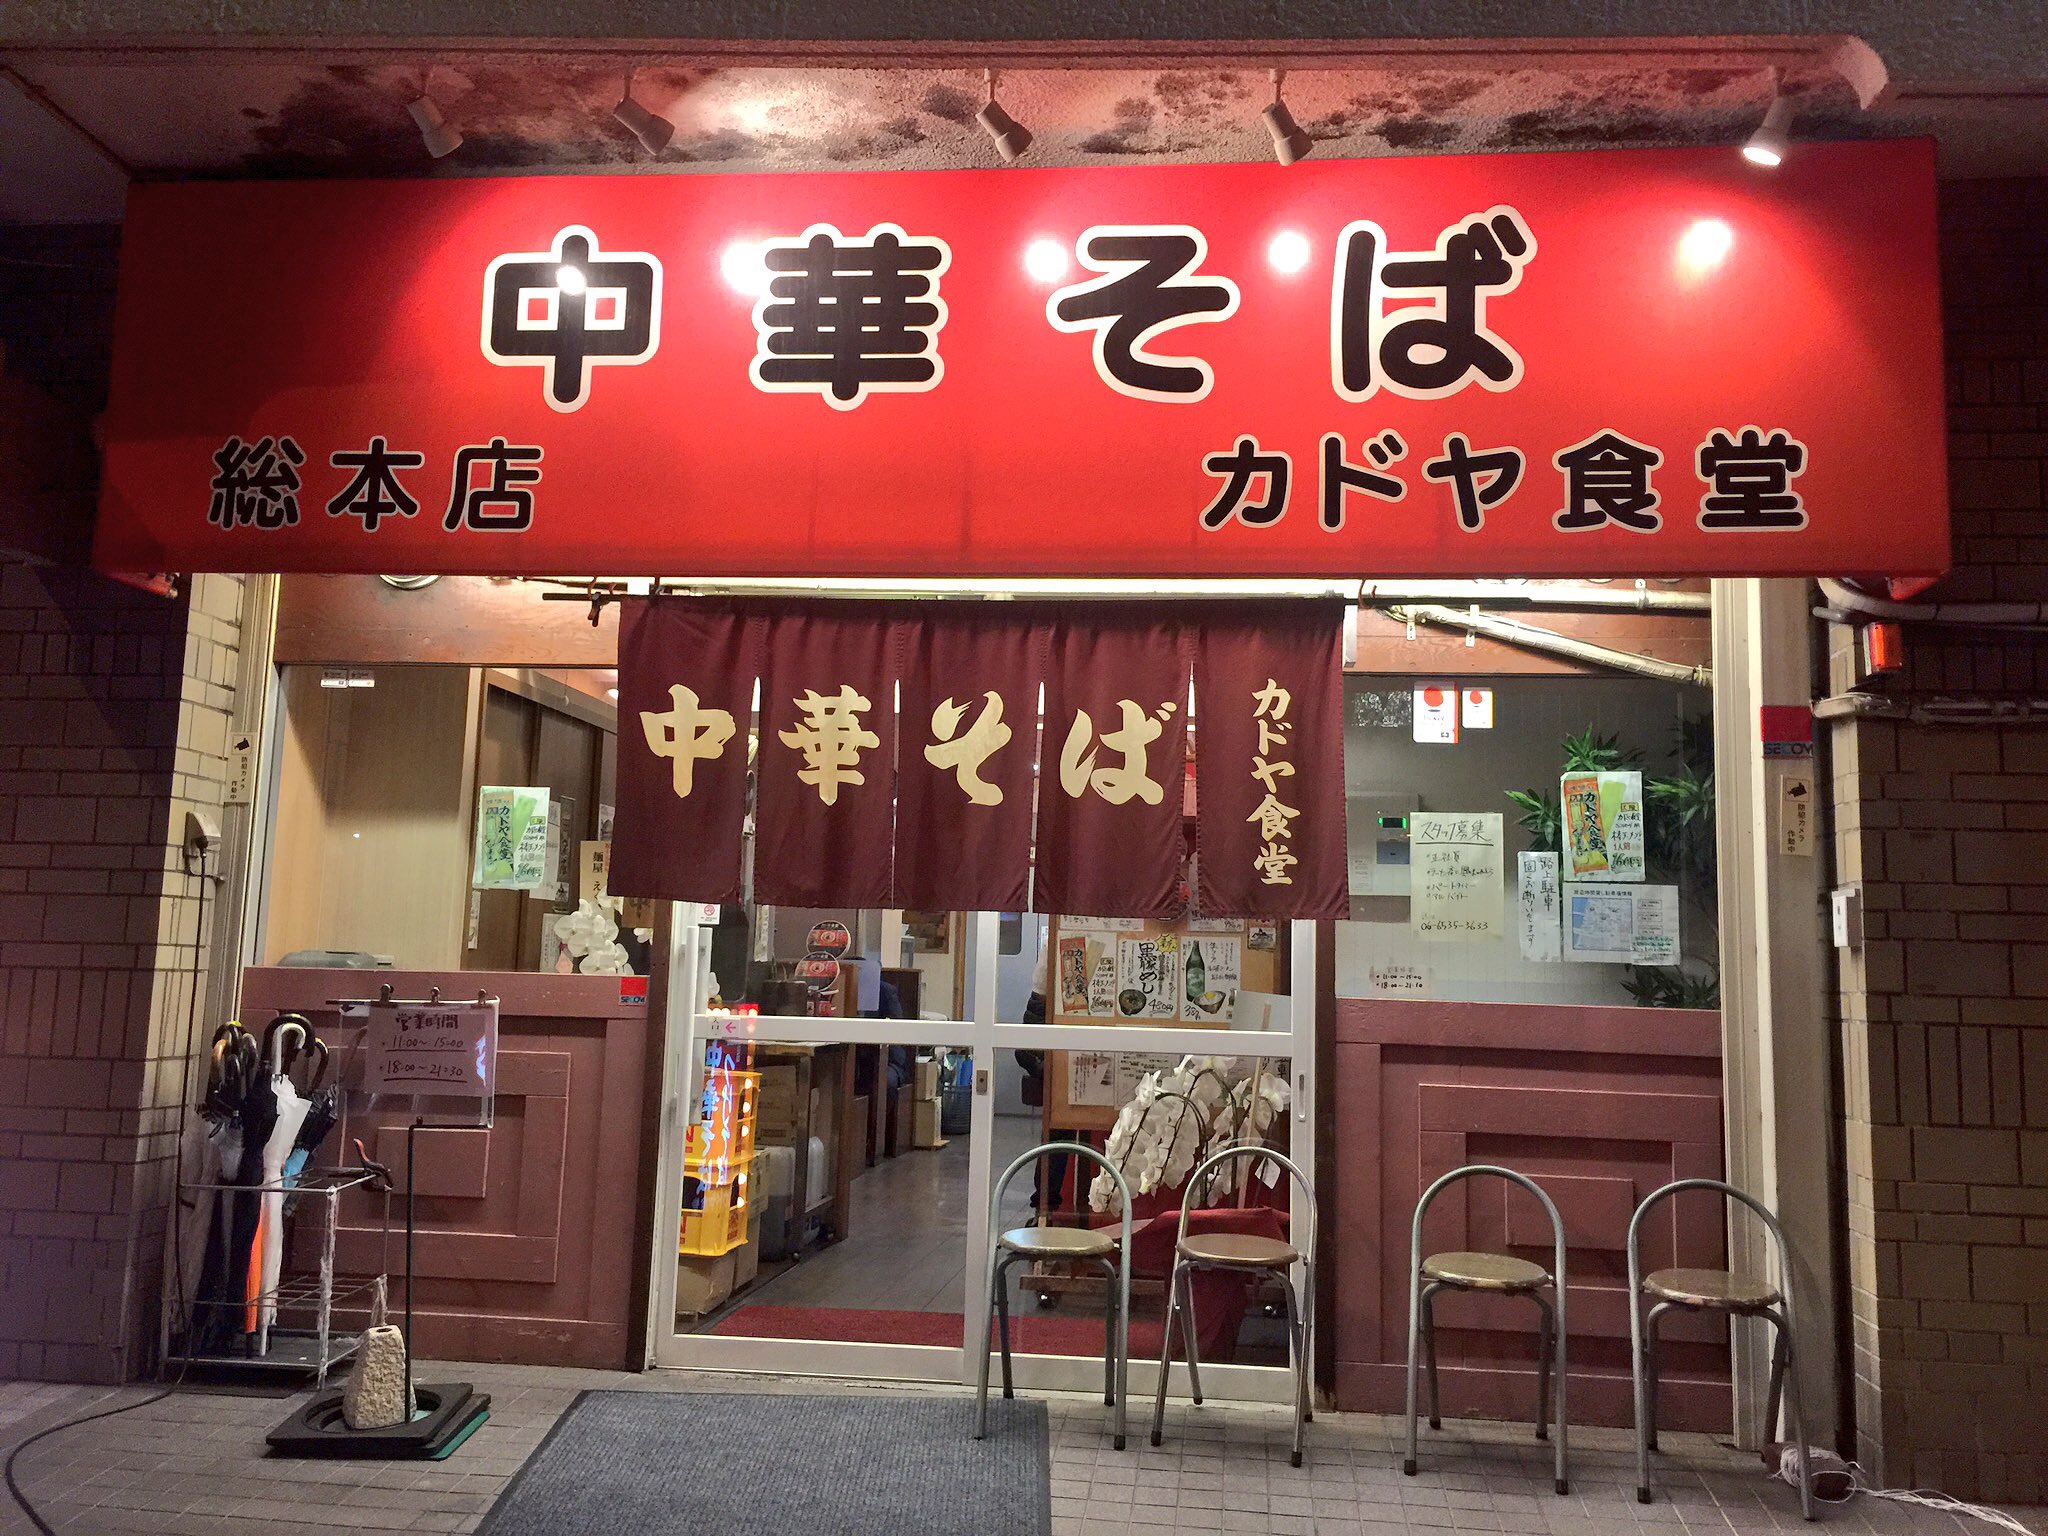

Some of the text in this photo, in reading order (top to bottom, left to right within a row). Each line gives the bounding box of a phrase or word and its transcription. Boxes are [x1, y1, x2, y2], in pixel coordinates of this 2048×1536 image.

[480, 204, 1538, 413] 中華そば
[207, 434, 543, 534] 総本店
[1198, 424, 1809, 534] カドヤ食堂
[639, 683, 1177, 806] 中華そば
[1246, 678, 1300, 885] カドヤ食堂
[1763, 742, 1813, 755] SECOM
[1420, 819, 1492, 842] スタッフ募集
[1539, 856, 1556, 912] 路上駐車
[1138, 942, 1158, 994] 黒豚めし
[396, 1011, 460, 1032] 営業時間
